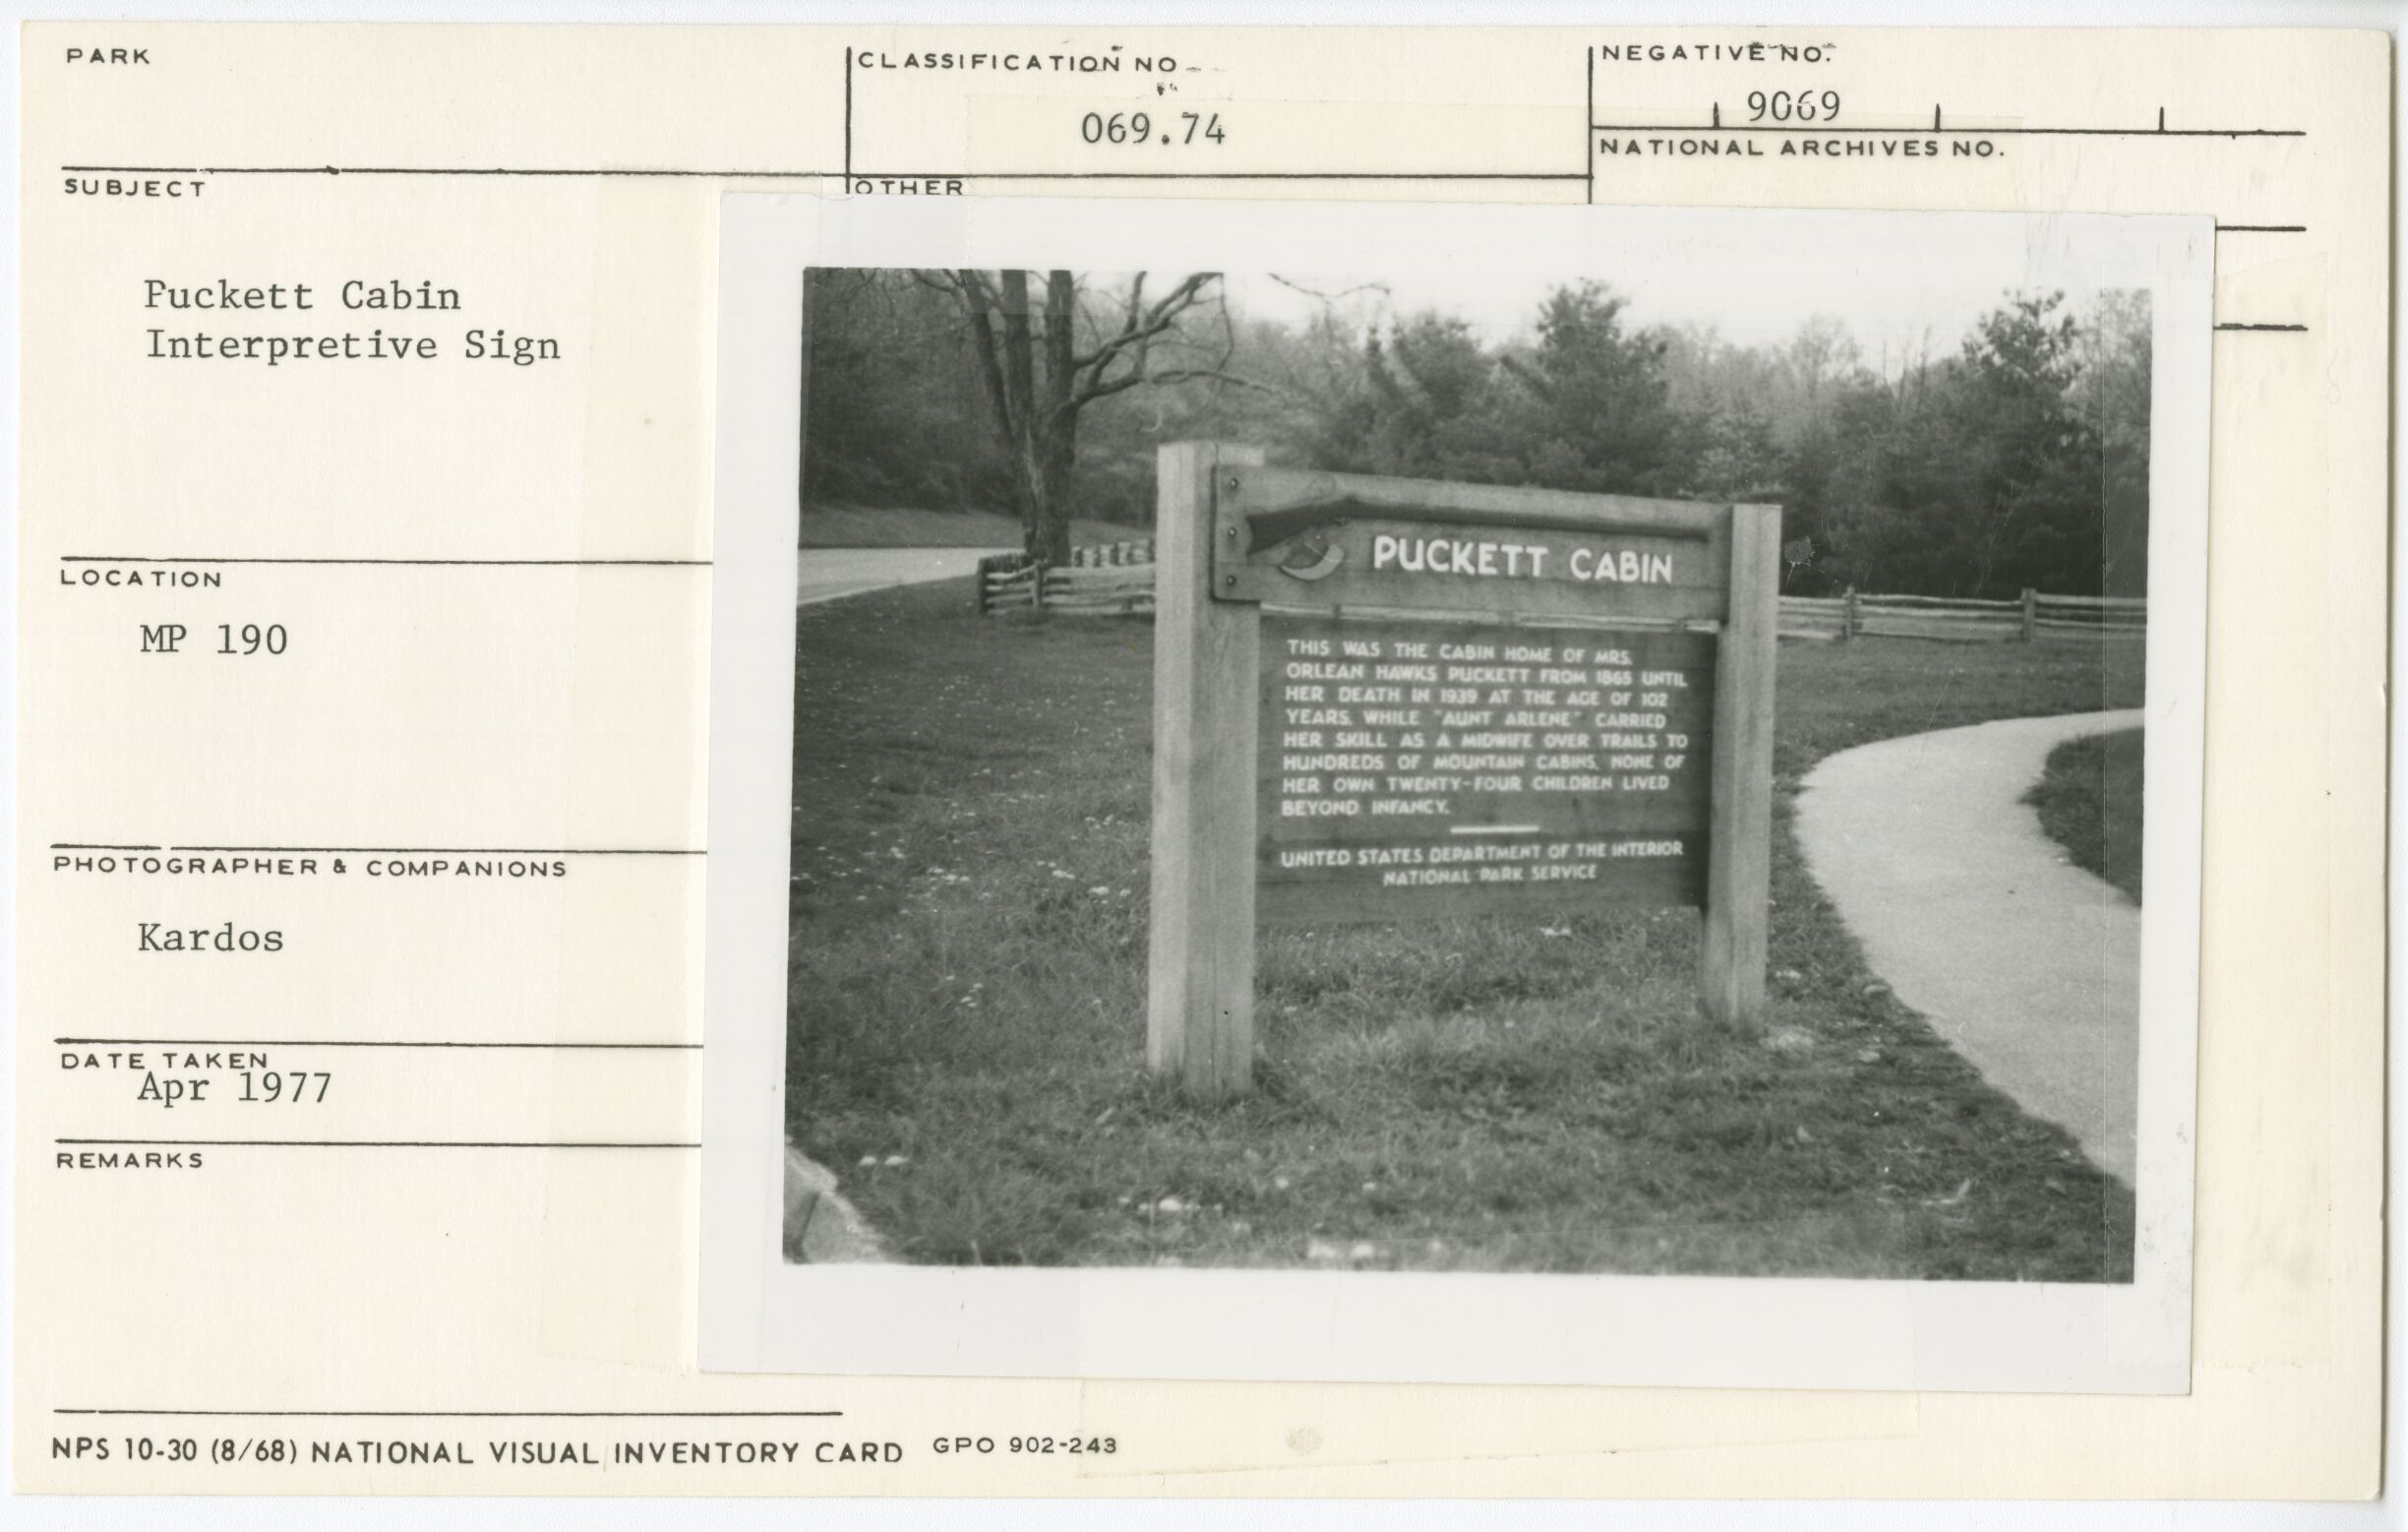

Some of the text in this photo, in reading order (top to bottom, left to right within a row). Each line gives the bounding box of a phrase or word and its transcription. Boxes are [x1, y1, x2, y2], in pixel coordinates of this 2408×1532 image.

[67, 48, 150, 64] PARK
[858, 52, 1120, 72] CLASSIFICATION
[1602, 44, 1832, 63] NEGATIVE NO.
[1747, 91, 1841, 122] 9069
[1082, 112, 1226, 146] 069.74
[1599, 139, 2006, 158] NATIONAL ARCHIVES NO.
[64, 179, 206, 197] SUBJECT
[855, 180, 963, 196] OTHER
[145, 279, 461, 310] Puckett Cabin
[147, 329, 561, 366] Interpretive Sign
[1375, 535, 1672, 583] PUCKETT CABIN
[61, 569, 221, 587] LOCATION
[140, 624, 288, 654] MP 190
[1287, 640, 1633, 665] THIS WAS THE CABIN HOME OF MRS.
[1287, 662, 1687, 688] ORLEAN HAWKS PUCKETT FROM 1865 UNTIL
[1285, 686, 1668, 707] HER DEATH IN 1939 AT THE AGE OF 102
[1363, 710, 1419, 726] WHILE
[1595, 713, 1666, 729] CARRIED
[1283, 731, 1688, 749] HER SKILL AS A MIDWIFE OVER TRAILS TO
[1283, 754, 1384, 771] HUNDREDS
[1398, 755, 1421, 770] OF
[1433, 755, 1525, 770] MOUNTAIN
[1610, 755, 1655, 769] NONE
[1664, 755, 1685, 769] OF
[1283, 775, 1669, 794] HER OWN TWENTY-FOUR CHILDREN LIVED
[1282, 799, 1359, 817] BEYOND
[1281, 841, 1683, 868] UNITED STATES DEPARTMENT OF THE INTERIOR
[53, 856, 567, 877] PHOTOGRAPHER & COMPANIONS
[1383, 864, 1597, 886] NATIONAL PARK SERVICE
[138, 923, 283, 952] Kardos
[61, 1053, 268, 1070] DATE TAKEN
[138, 1072, 332, 1108] Apr 1977
[57, 1152, 204, 1169] REMARKS
[51, 1437, 905, 1466] NPS 10-30 (8/68) NATIONAL VISUAL INVENTORY CARD
[933, 1436, 1118, 1455] GPO 902-243
